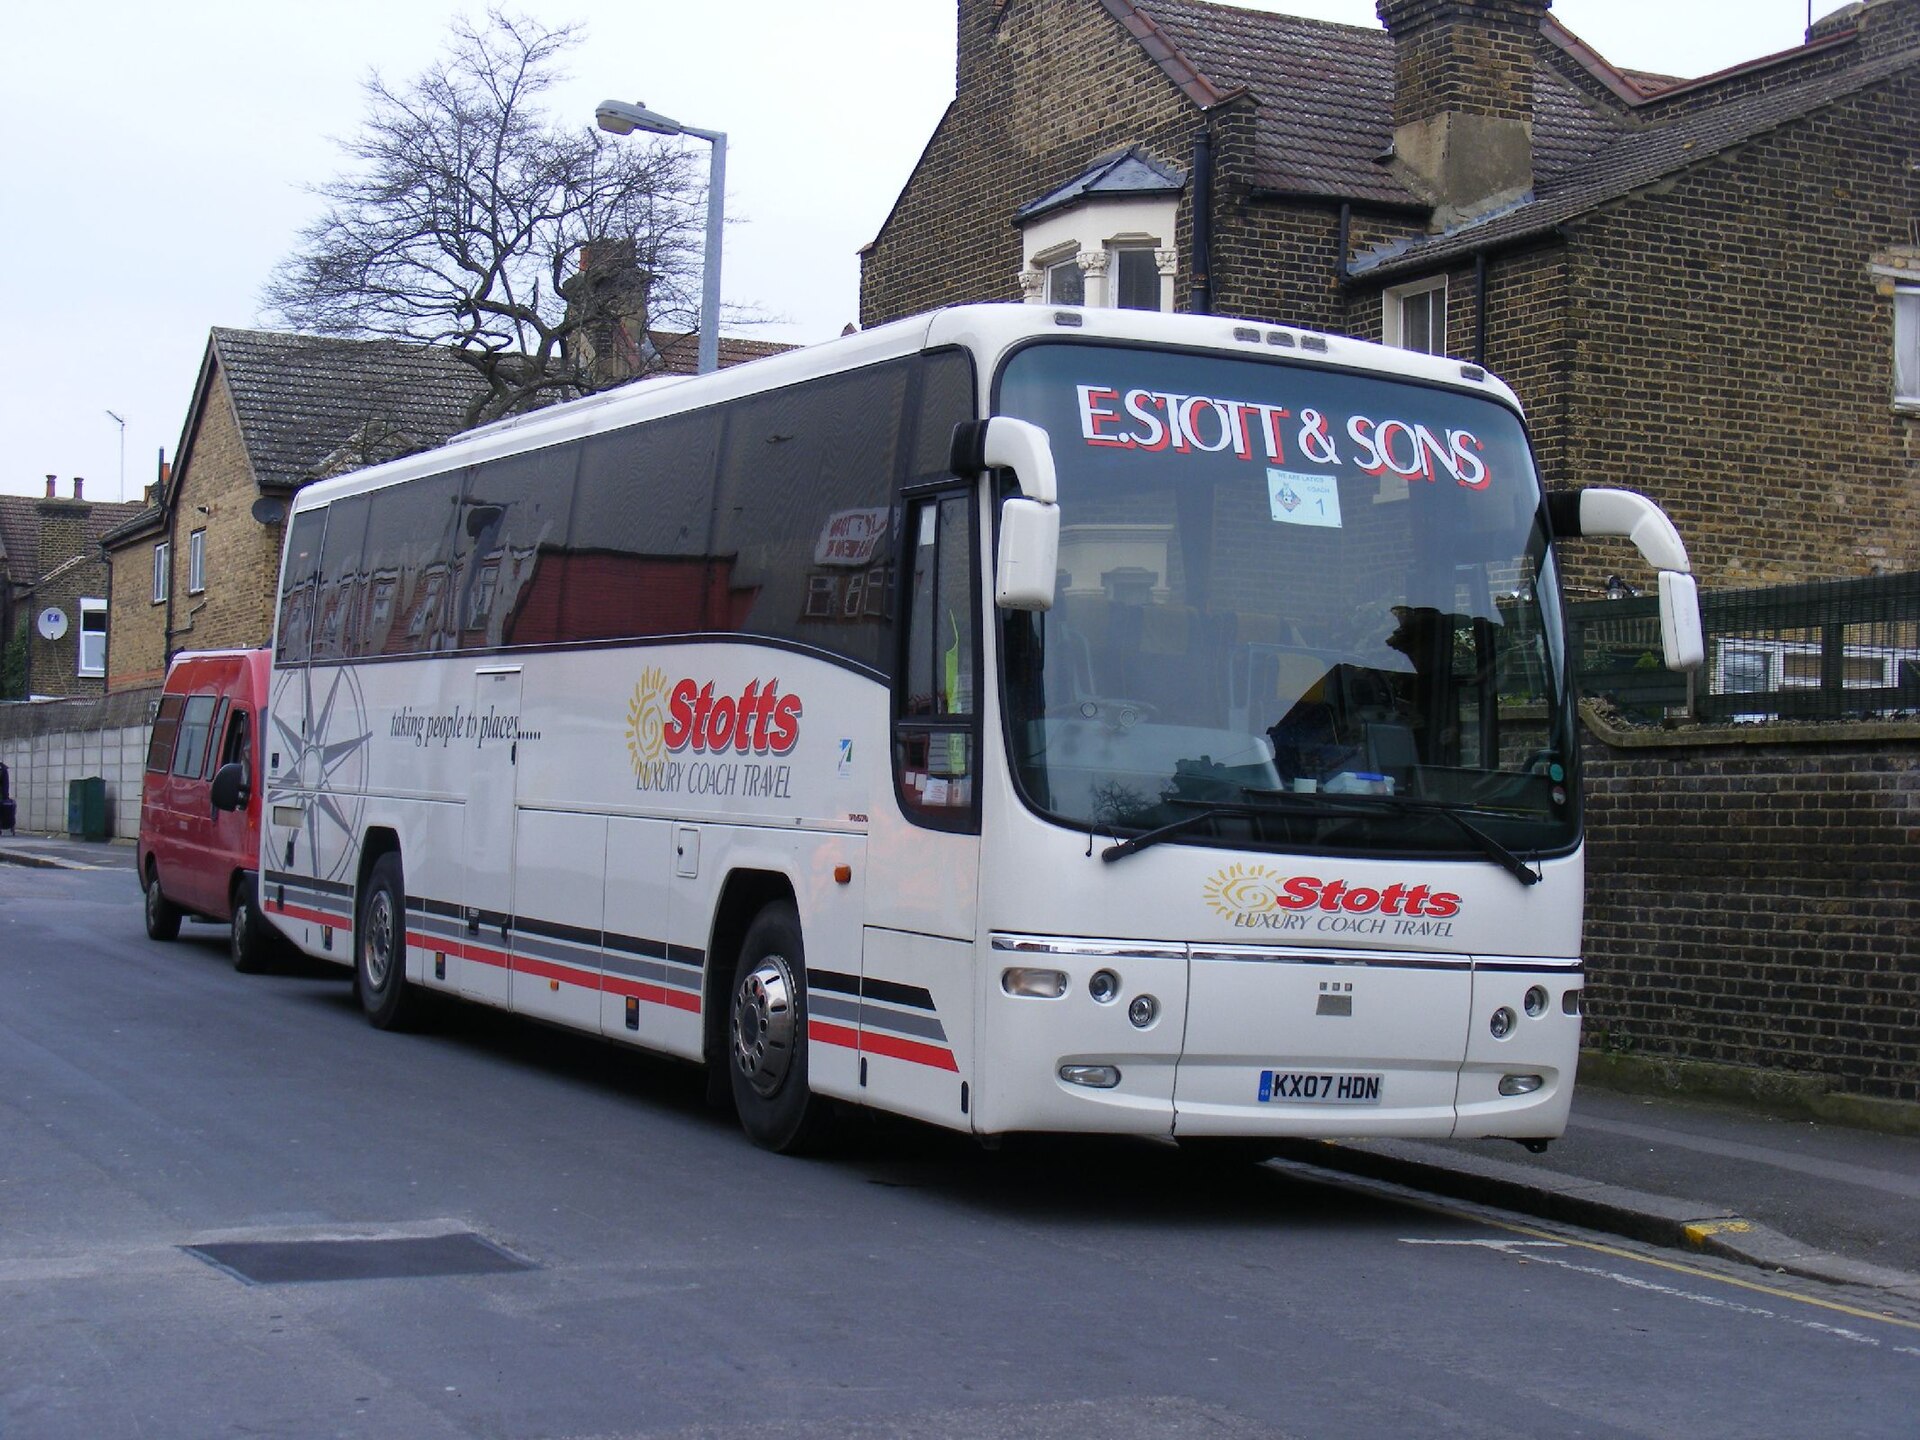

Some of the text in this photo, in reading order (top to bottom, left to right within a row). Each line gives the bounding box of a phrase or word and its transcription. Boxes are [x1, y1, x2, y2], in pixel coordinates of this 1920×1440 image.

[1298, 408, 1342, 465] &
[1346, 414, 1491, 491] SONS
[1316, 498, 1324, 516] 1
[390, 706, 425, 747] taking
[424, 705, 464, 747] people
[465, 710, 477, 738] to
[664, 676, 802, 757] Stotts
[636, 761, 791, 798] LUXURY COACH TRAVEL
[1276, 876, 1462, 918] Stotts
[1234, 912, 1454, 937] LUXURY COACH TRAVEL
[1273, 1074, 1380, 1099] KX07 HDN
